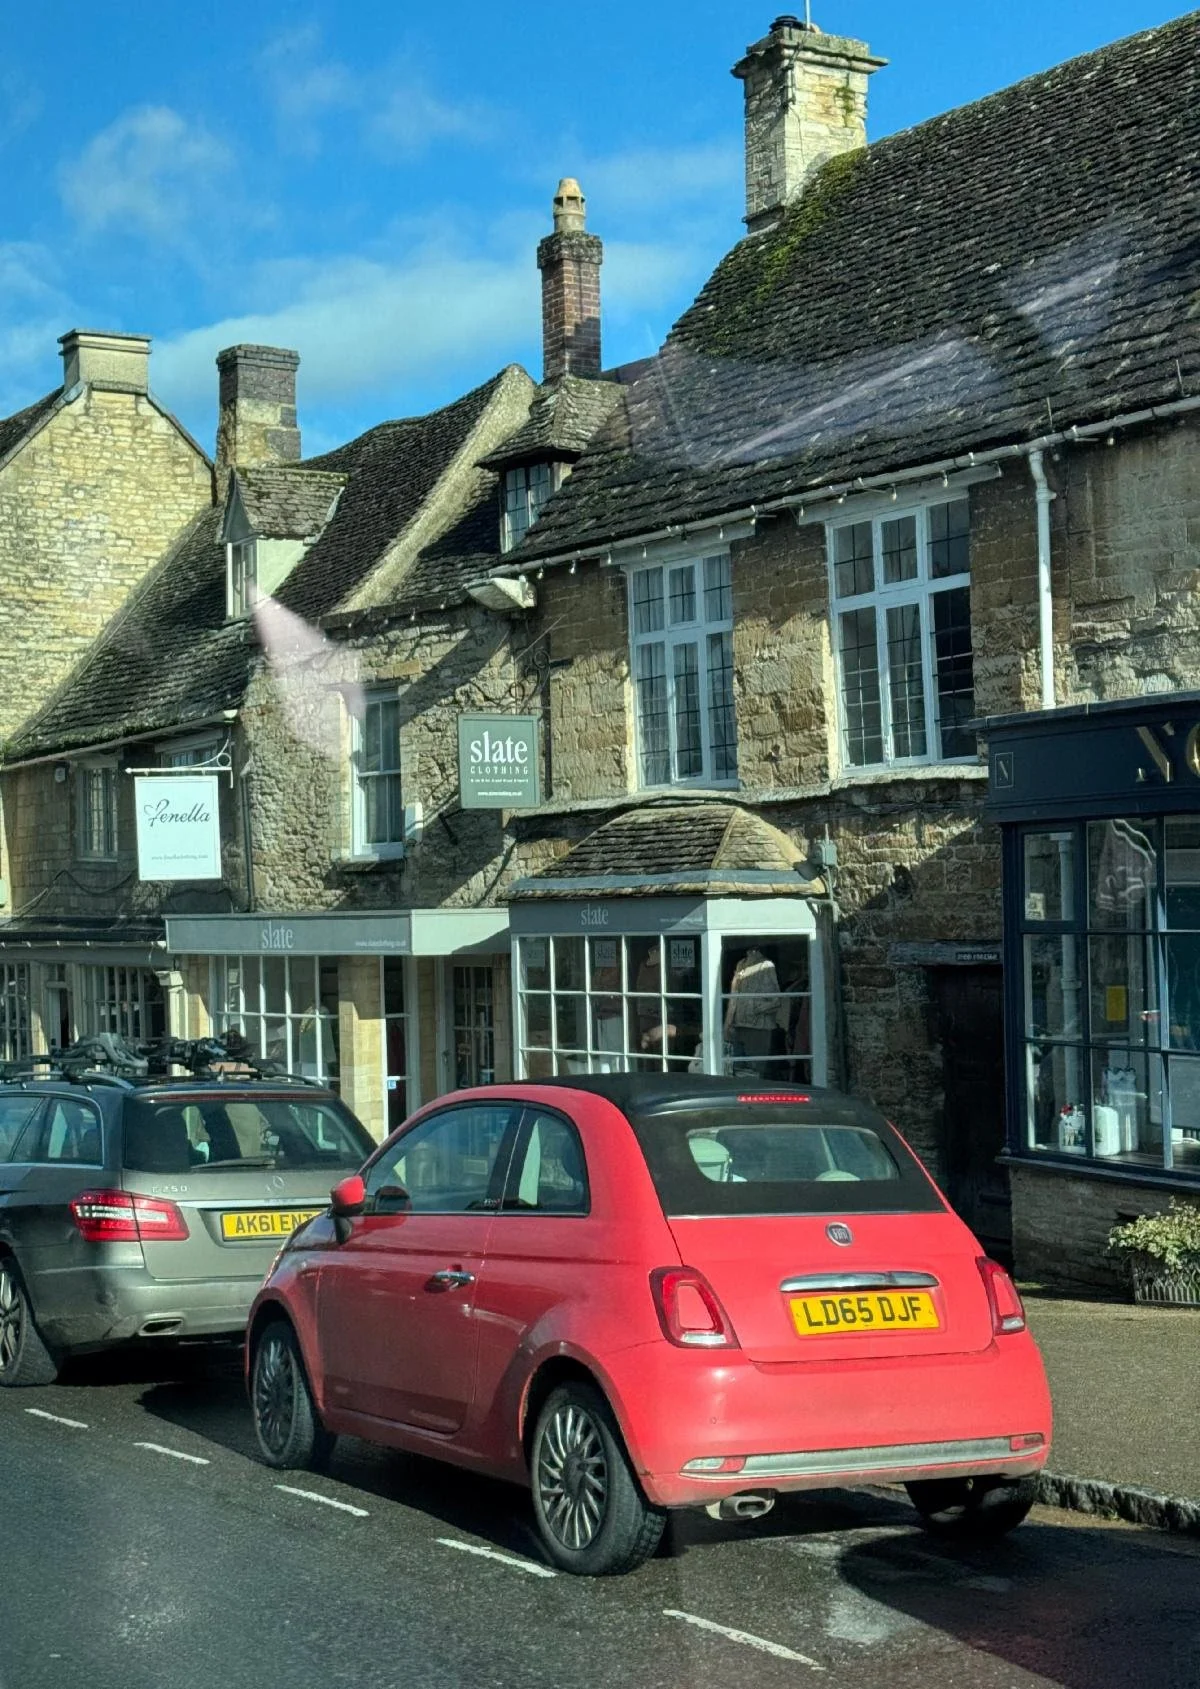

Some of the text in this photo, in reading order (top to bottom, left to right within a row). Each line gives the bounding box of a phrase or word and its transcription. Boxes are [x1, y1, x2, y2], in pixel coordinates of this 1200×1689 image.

[470, 730, 528, 764] slate
[470, 766, 529, 775] CLOTHING
[581, 904, 608, 925] slate
[261, 921, 293, 948] slate
[235, 1214, 276, 1234] AK61
[803, 1295, 922, 1327] LD65 DJF
